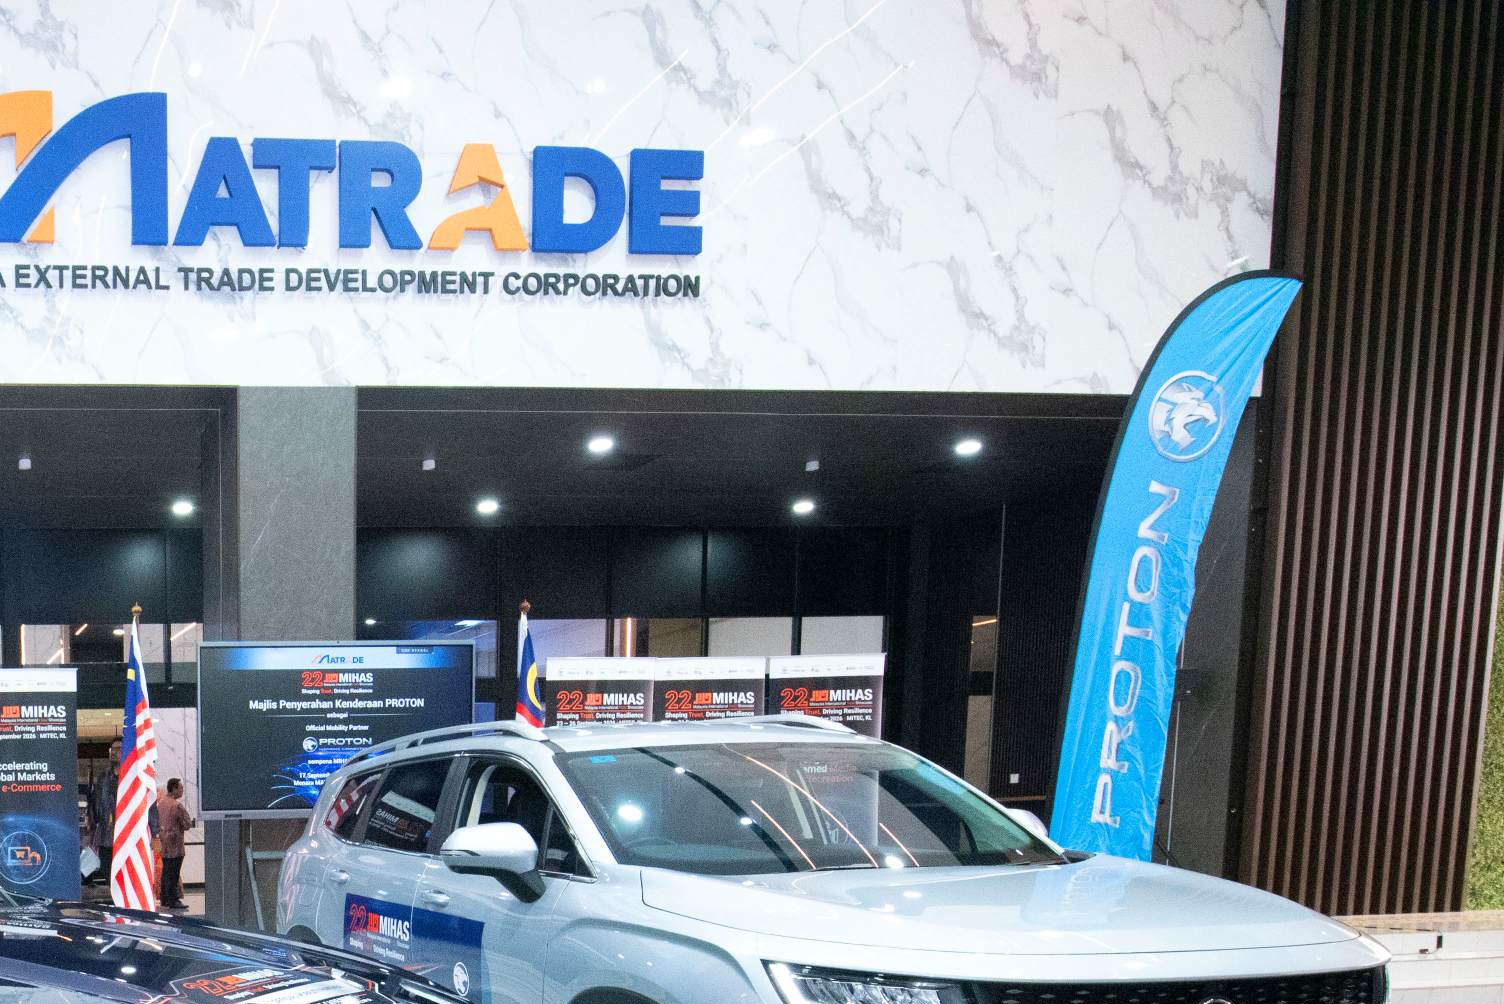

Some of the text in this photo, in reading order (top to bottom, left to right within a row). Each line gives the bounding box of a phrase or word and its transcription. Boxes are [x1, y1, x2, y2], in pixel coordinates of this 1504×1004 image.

[14, 264, 170, 291] EXTERNAL
[177, 266, 275, 293] TRADE
[284, 268, 495, 296] DEVELOPMENT
[502, 271, 700, 299] CORPORATION
[1090, 480, 1180, 827] PROTON
[301, 671, 374, 687] 22 MIHAS
[249, 698, 425, 711] Majlis Penyerahan Kenderaan PROTON
[557, 690, 583, 710] 22
[603, 693, 645, 706] MIHAS
[665, 690, 691, 710] 22
[712, 691, 755, 704] MIHAS
[780, 687, 808, 707] 22
[829, 688, 873, 701] MIHAS
[20, 705, 67, 718] MIHAS
[326, 724, 348, 732] Mobility
[319, 737, 372, 745] PROTON
[17, 772, 55, 781] Markets
[1, 783, 62, 792] e-Commerce
[379, 915, 410, 942] MIHAS
